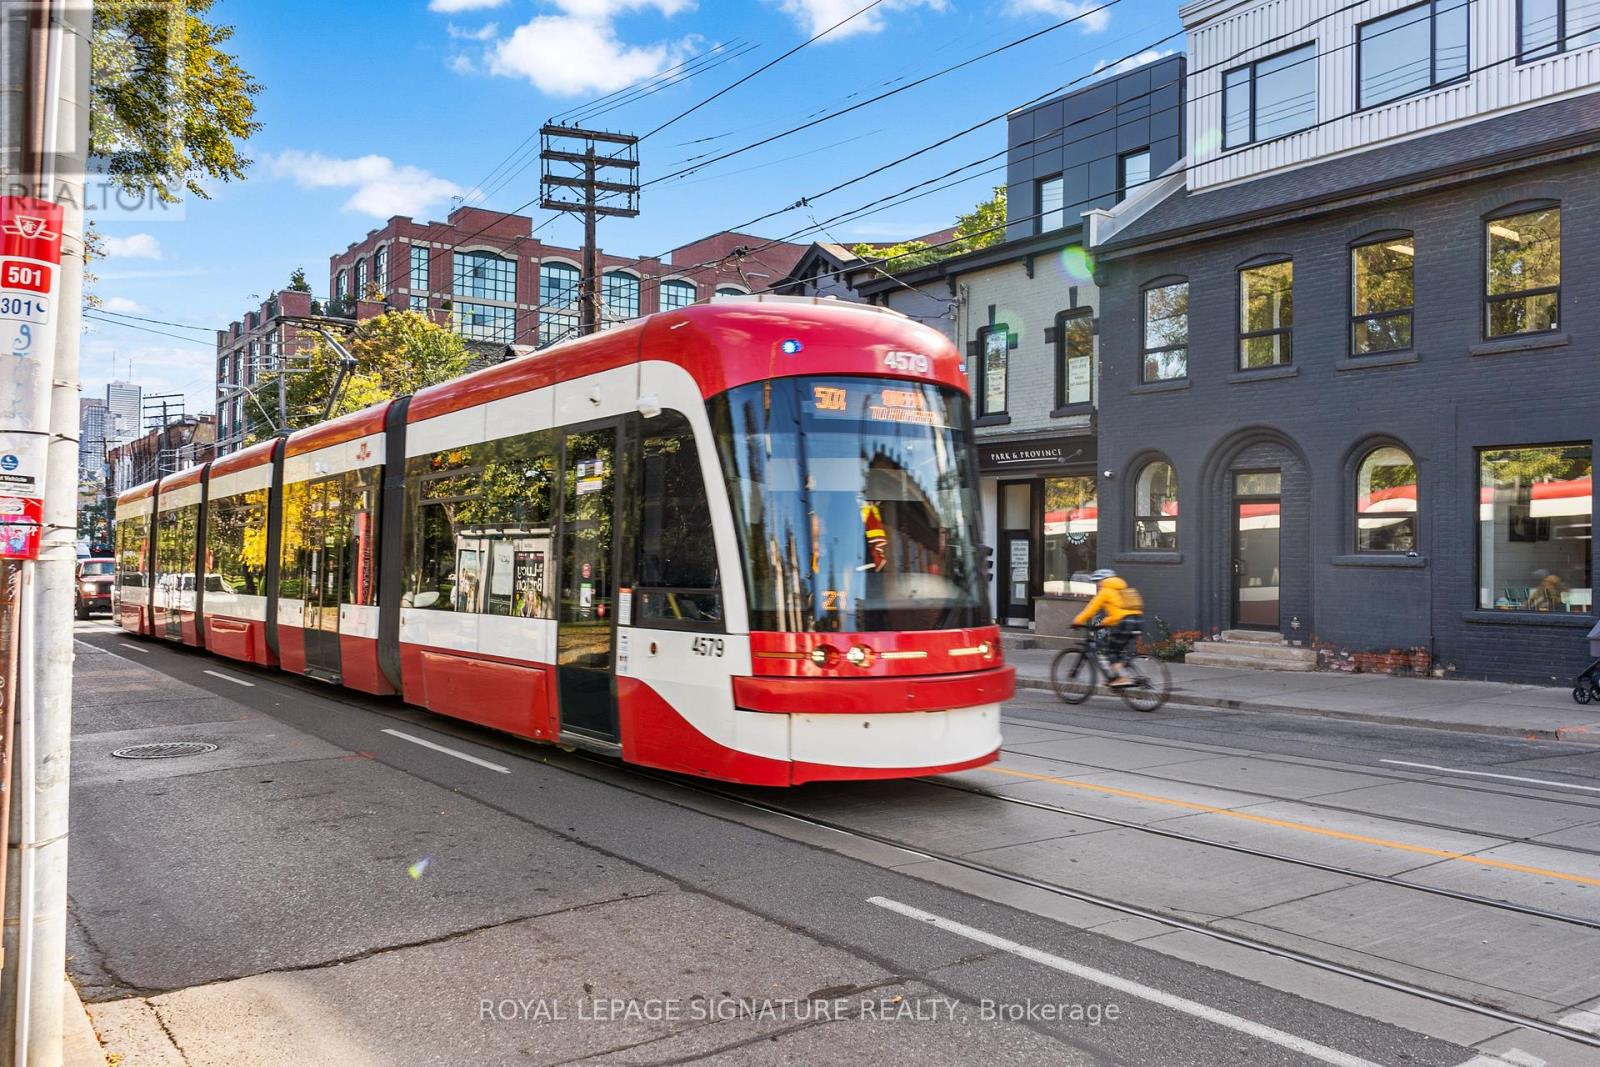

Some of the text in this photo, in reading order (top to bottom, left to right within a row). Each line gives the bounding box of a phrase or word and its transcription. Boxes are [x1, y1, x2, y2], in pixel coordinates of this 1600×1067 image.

[7, 266, 42, 287] 501
[0, 297, 31, 317] 301
[884, 351, 929, 373] 4579
[991, 448, 1063, 461] PARK & PROVINCE
[692, 636, 725, 658] 4579
